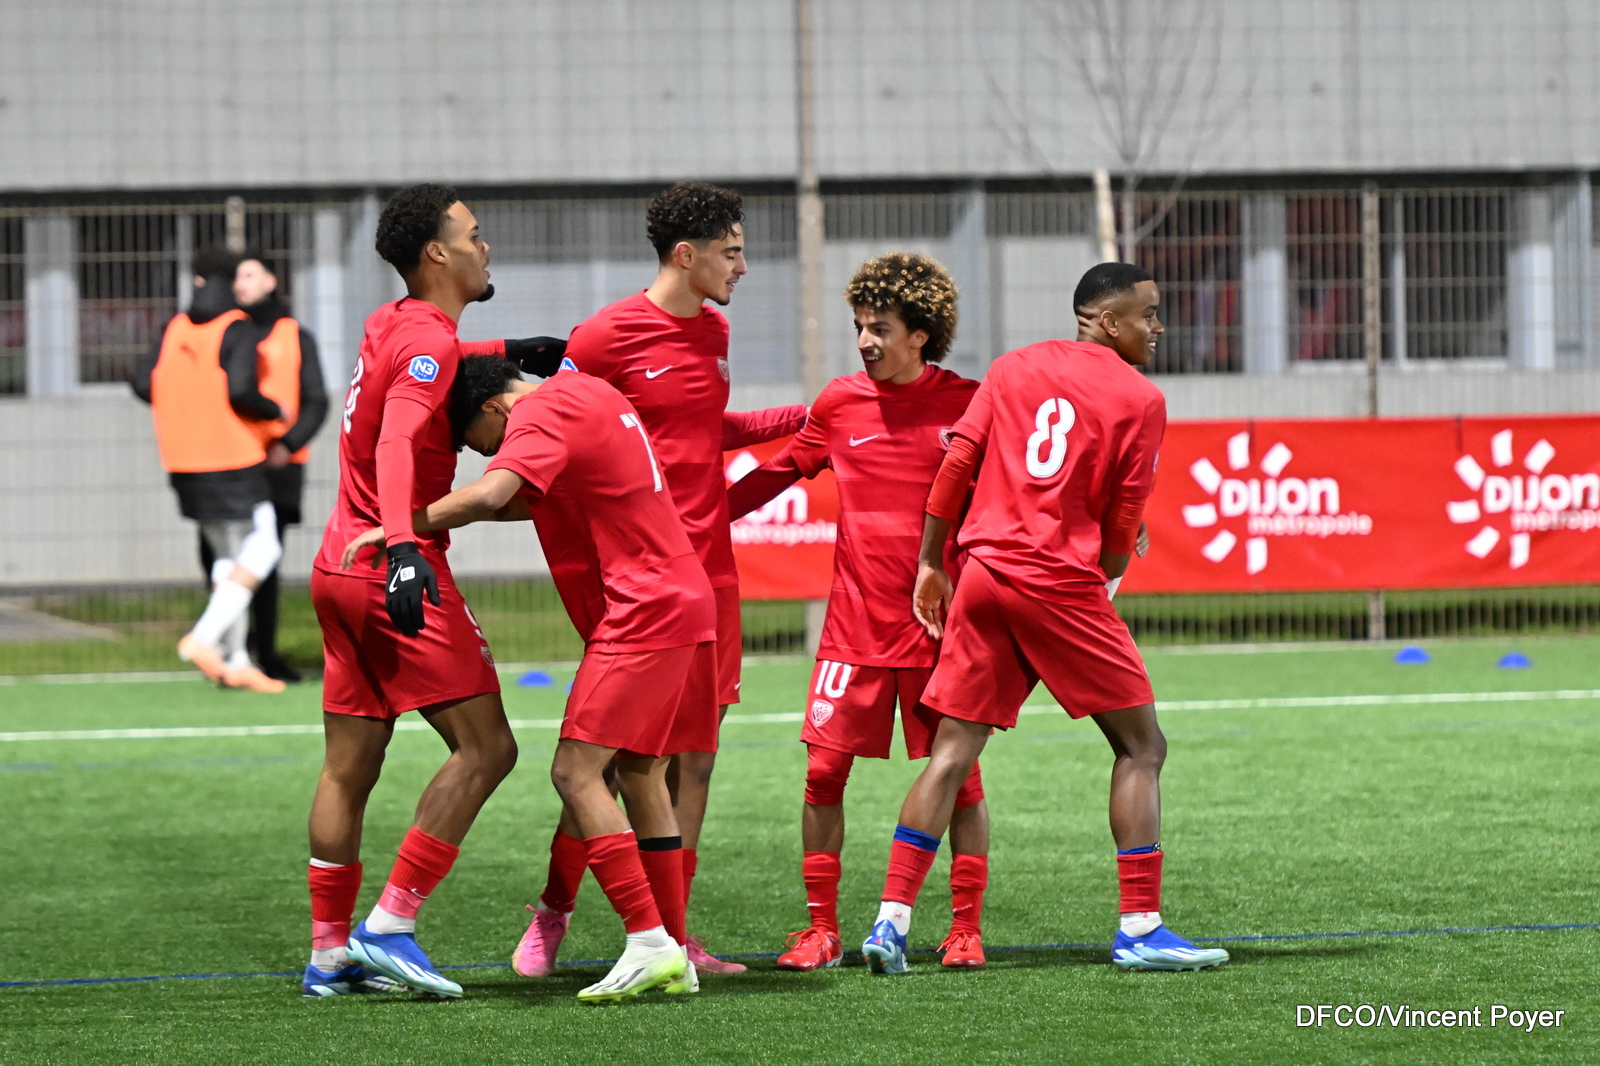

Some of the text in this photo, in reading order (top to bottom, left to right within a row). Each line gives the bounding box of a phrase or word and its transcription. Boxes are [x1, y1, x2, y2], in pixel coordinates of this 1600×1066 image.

[415, 360, 434, 375] N3
[619, 413, 663, 492] 7
[1026, 397, 1076, 478] 8
[815, 660, 852, 698] 10
